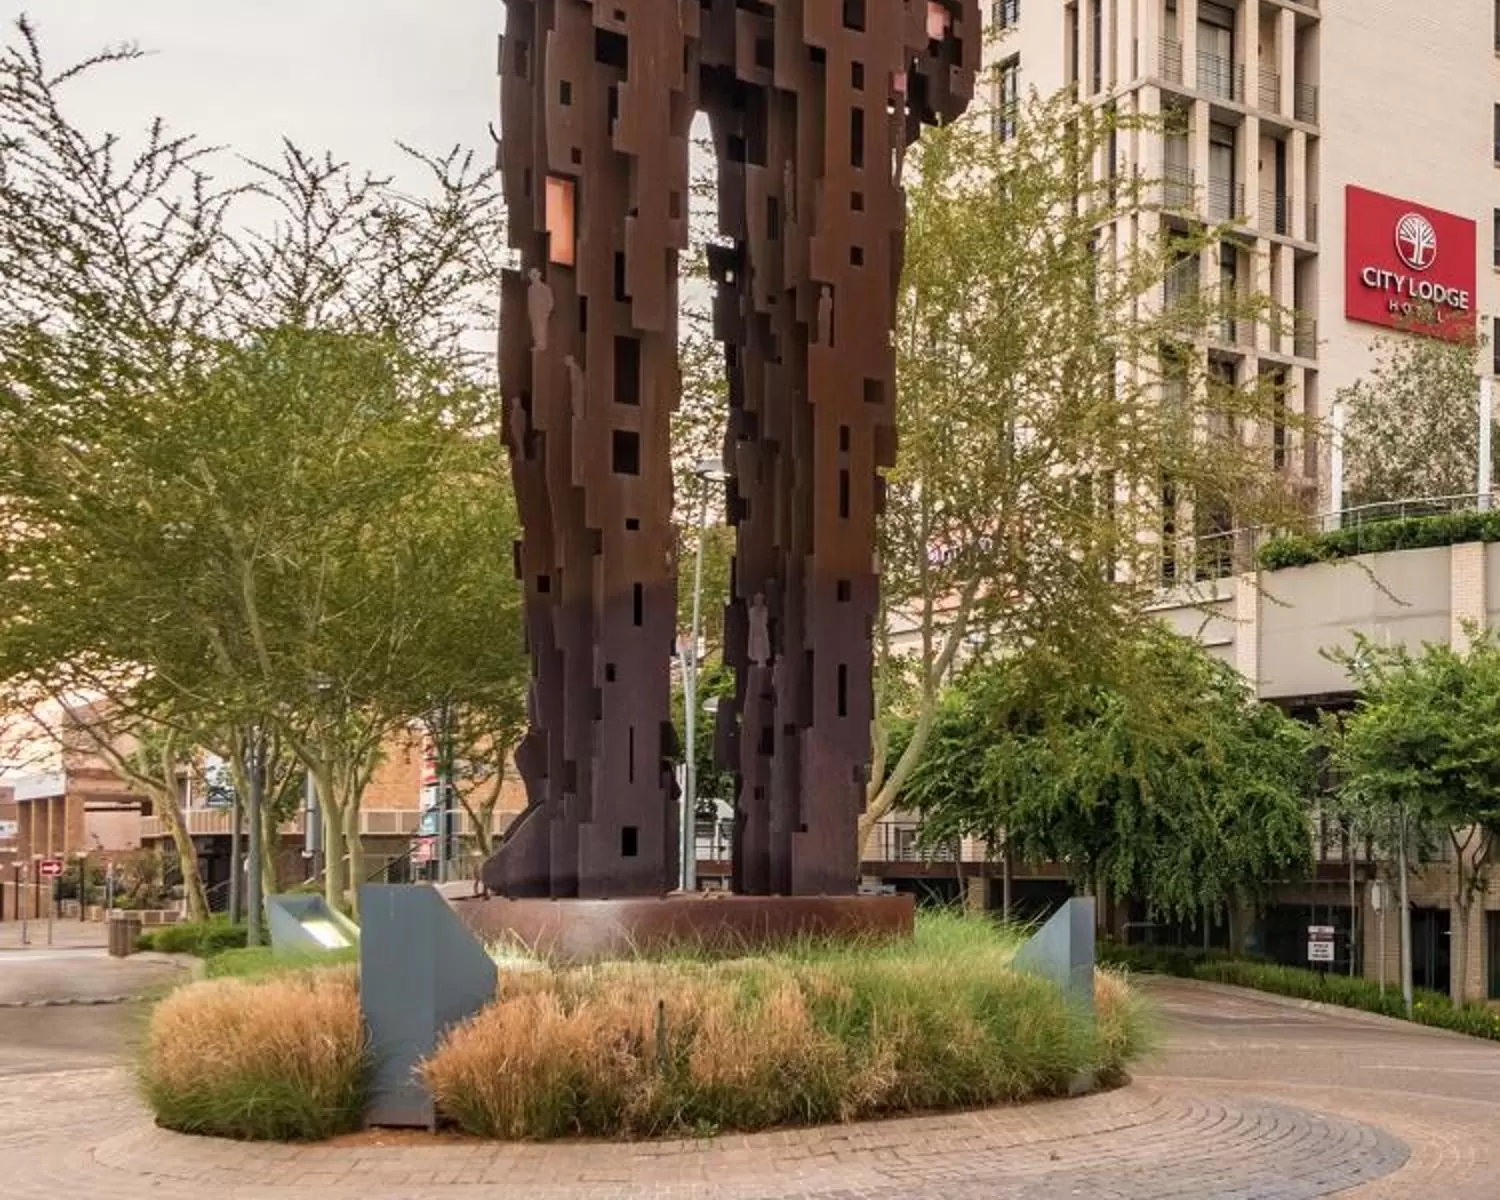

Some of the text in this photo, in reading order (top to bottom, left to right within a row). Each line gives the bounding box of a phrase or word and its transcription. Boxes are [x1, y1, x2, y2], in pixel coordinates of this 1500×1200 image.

[1362, 266, 1470, 310] CITY LODGE
[1388, 299, 1445, 323] HOL
